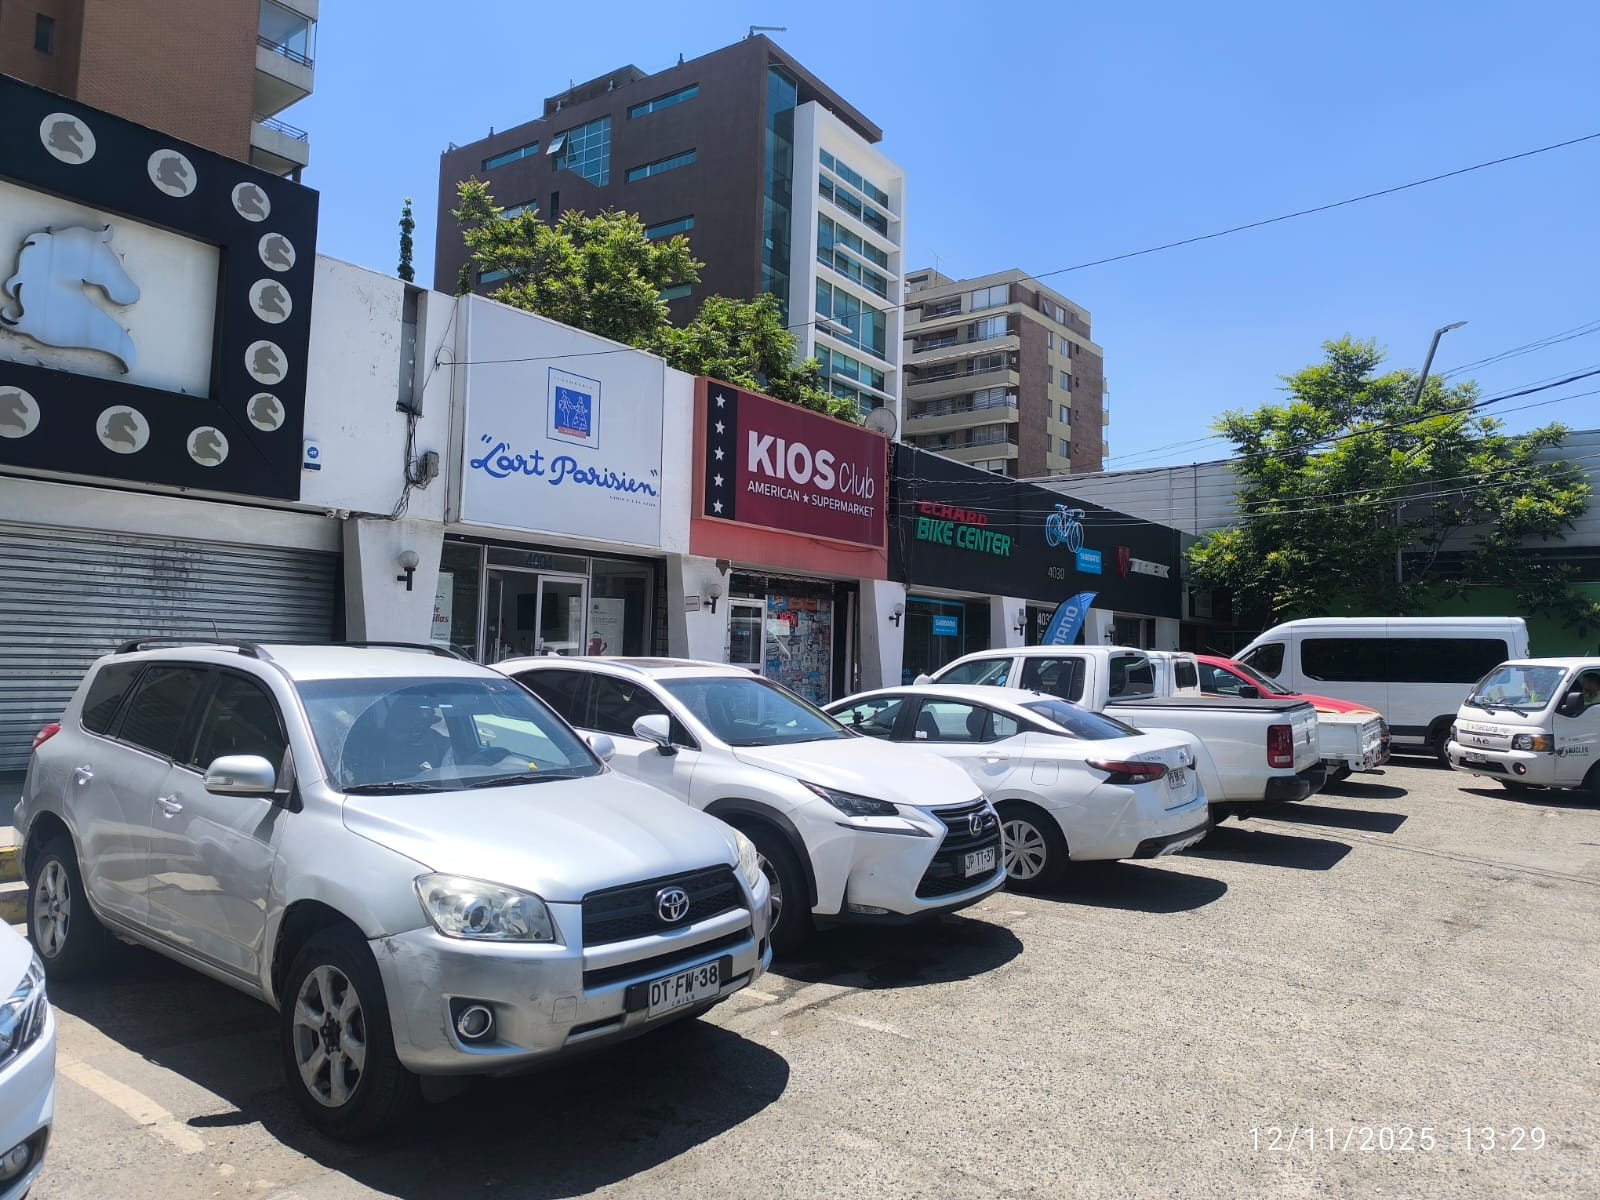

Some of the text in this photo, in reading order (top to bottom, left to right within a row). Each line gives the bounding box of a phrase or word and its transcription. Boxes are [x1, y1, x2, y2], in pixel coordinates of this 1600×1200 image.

[748, 430, 875, 499] KIOS Club
[747, 480, 875, 518] AMERICAN SUPERMARKET
[917, 516, 1011, 556] BIKE CENTER
[1047, 566, 1065, 580] 4030
[1037, 612, 1053, 626] 403
